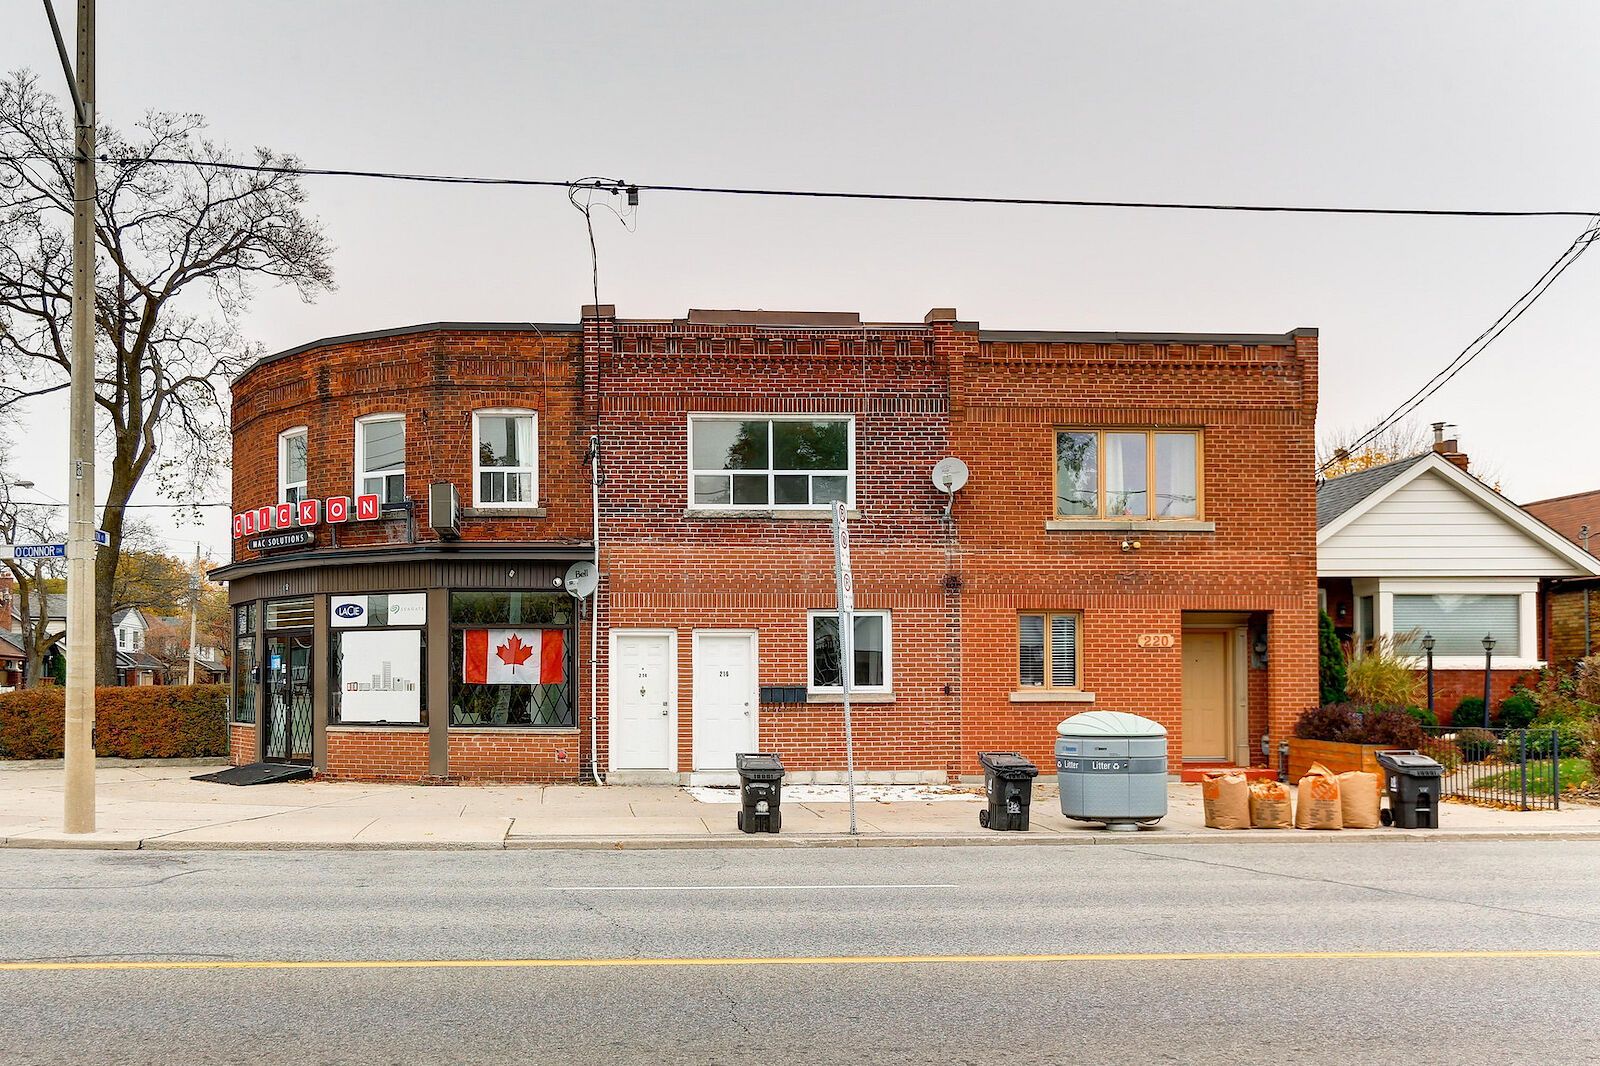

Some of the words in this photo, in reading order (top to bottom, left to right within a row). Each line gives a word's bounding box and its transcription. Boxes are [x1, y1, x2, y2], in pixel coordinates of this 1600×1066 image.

[252, 539, 265, 549] MAC
[268, 532, 305, 546] SOLUTIONS
[15, 545, 55, 557] O'CONNOR
[575, 569, 589, 578] Bell
[1144, 635, 1169, 647] 220
[1064, 760, 1079, 769] Litter
[1092, 760, 1111, 770] Litter
